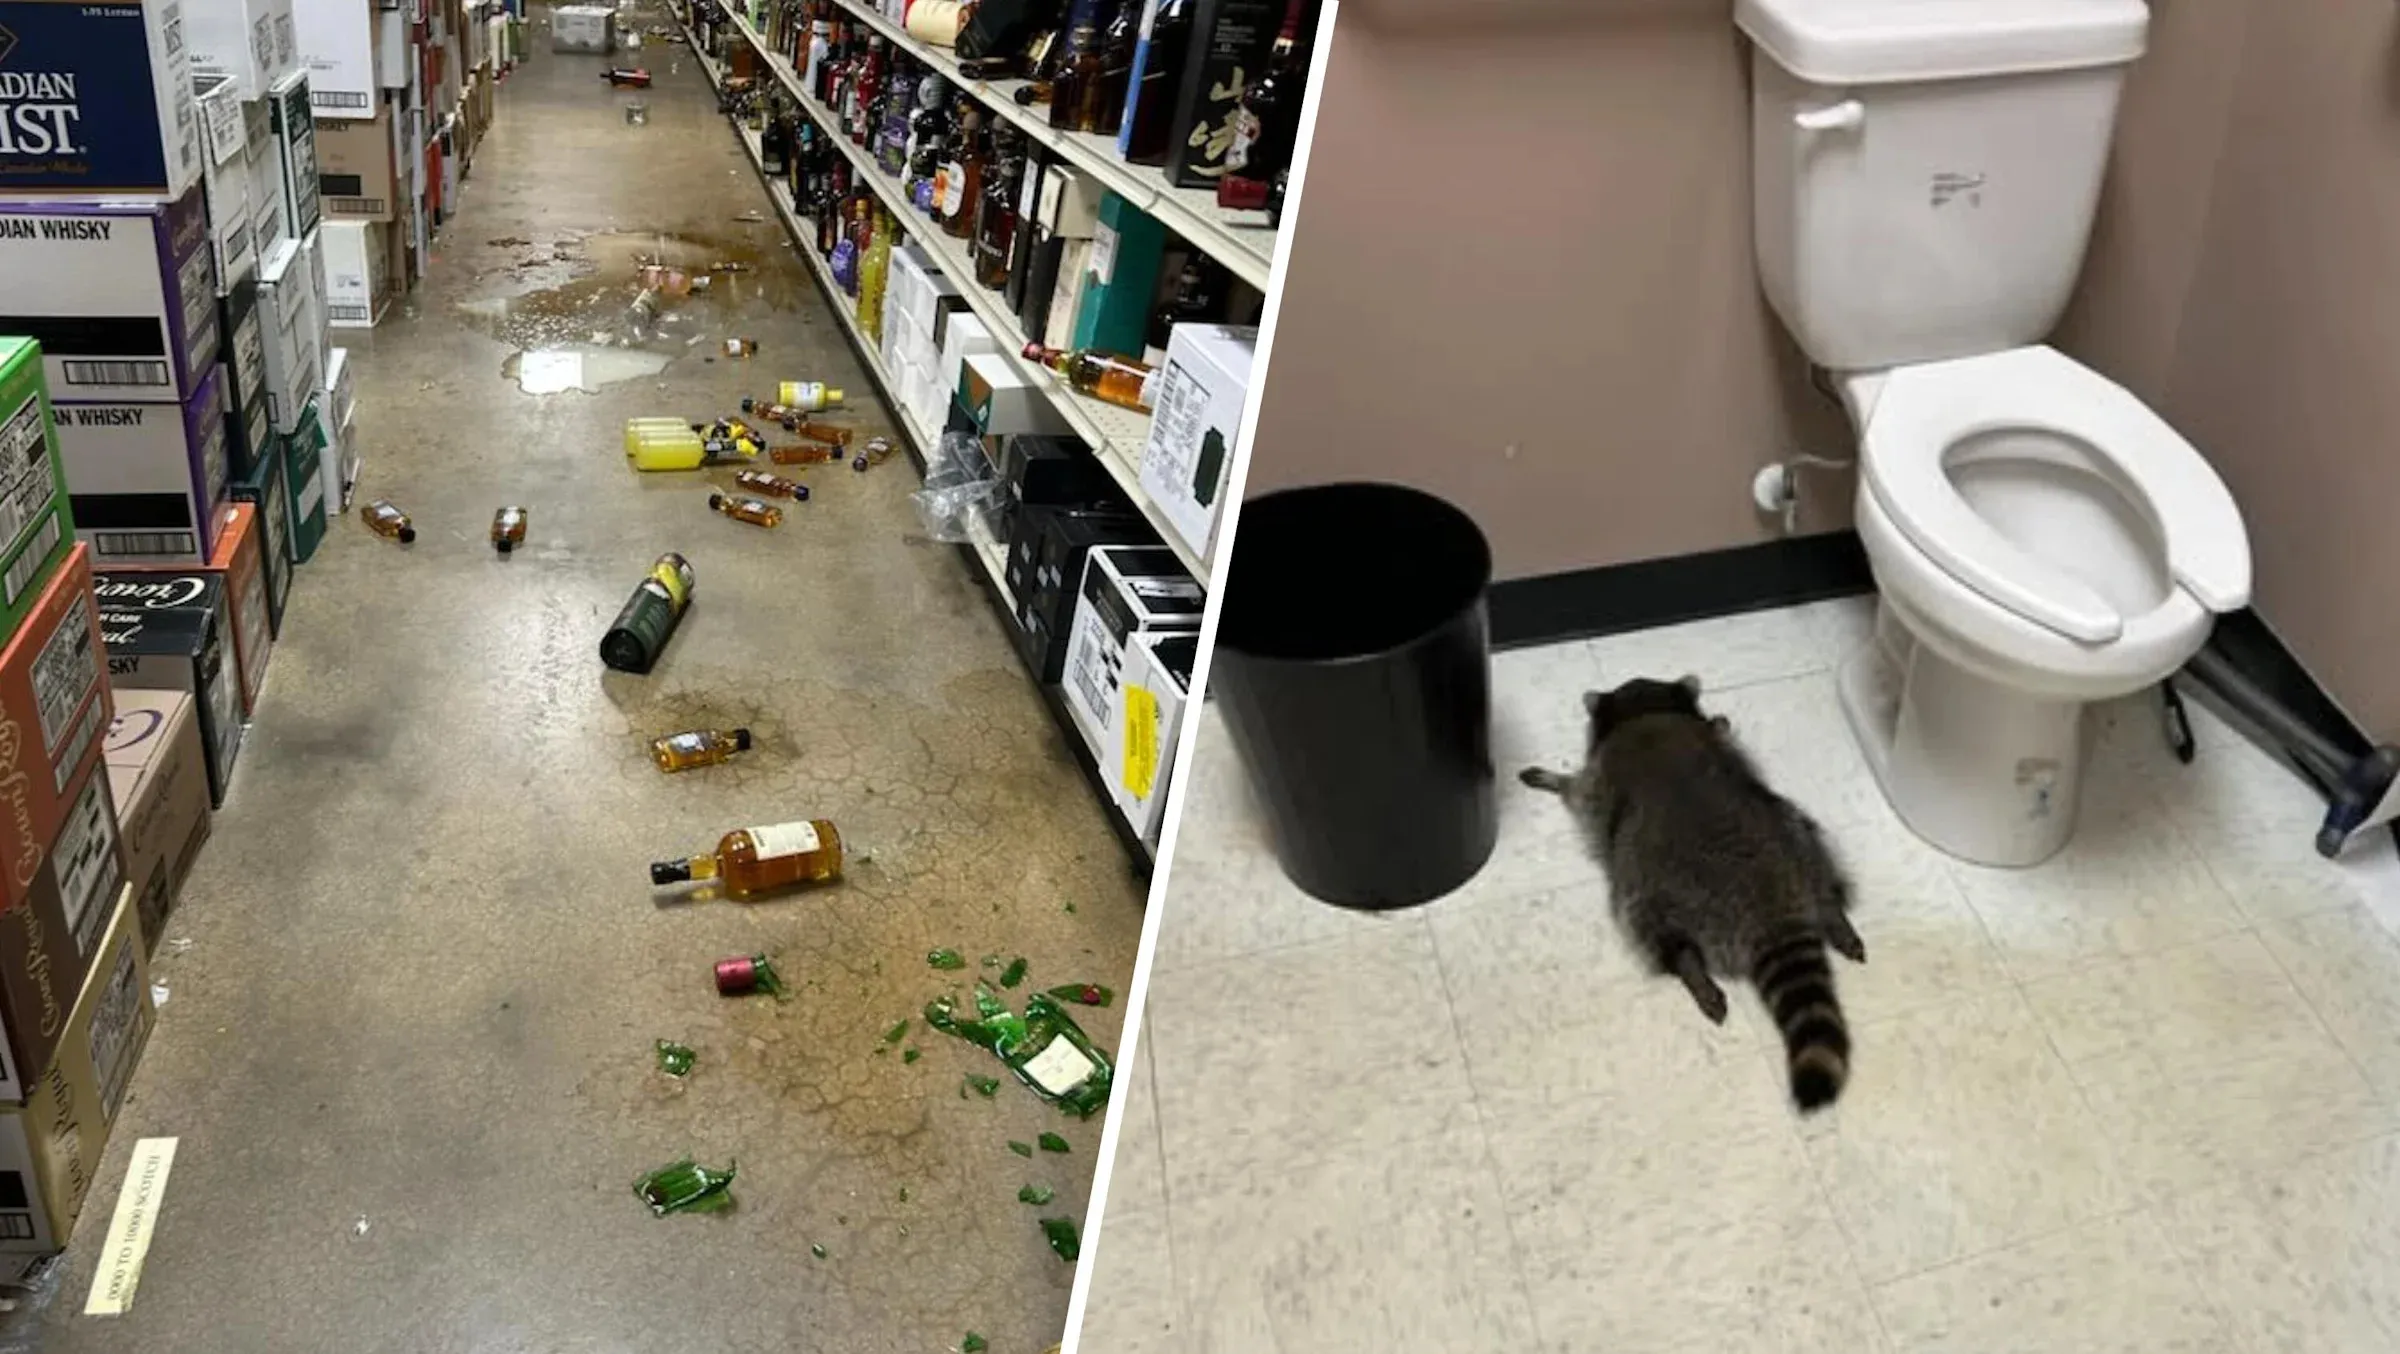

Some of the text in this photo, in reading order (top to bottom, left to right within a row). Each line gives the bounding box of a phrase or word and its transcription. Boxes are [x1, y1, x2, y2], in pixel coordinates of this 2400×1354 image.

[40, 220, 111, 240] WHISKY
[76, 408, 142, 426] WHISKY
[118, 1246, 132, 1265] TO
[134, 1154, 161, 1207] SCOTCH
